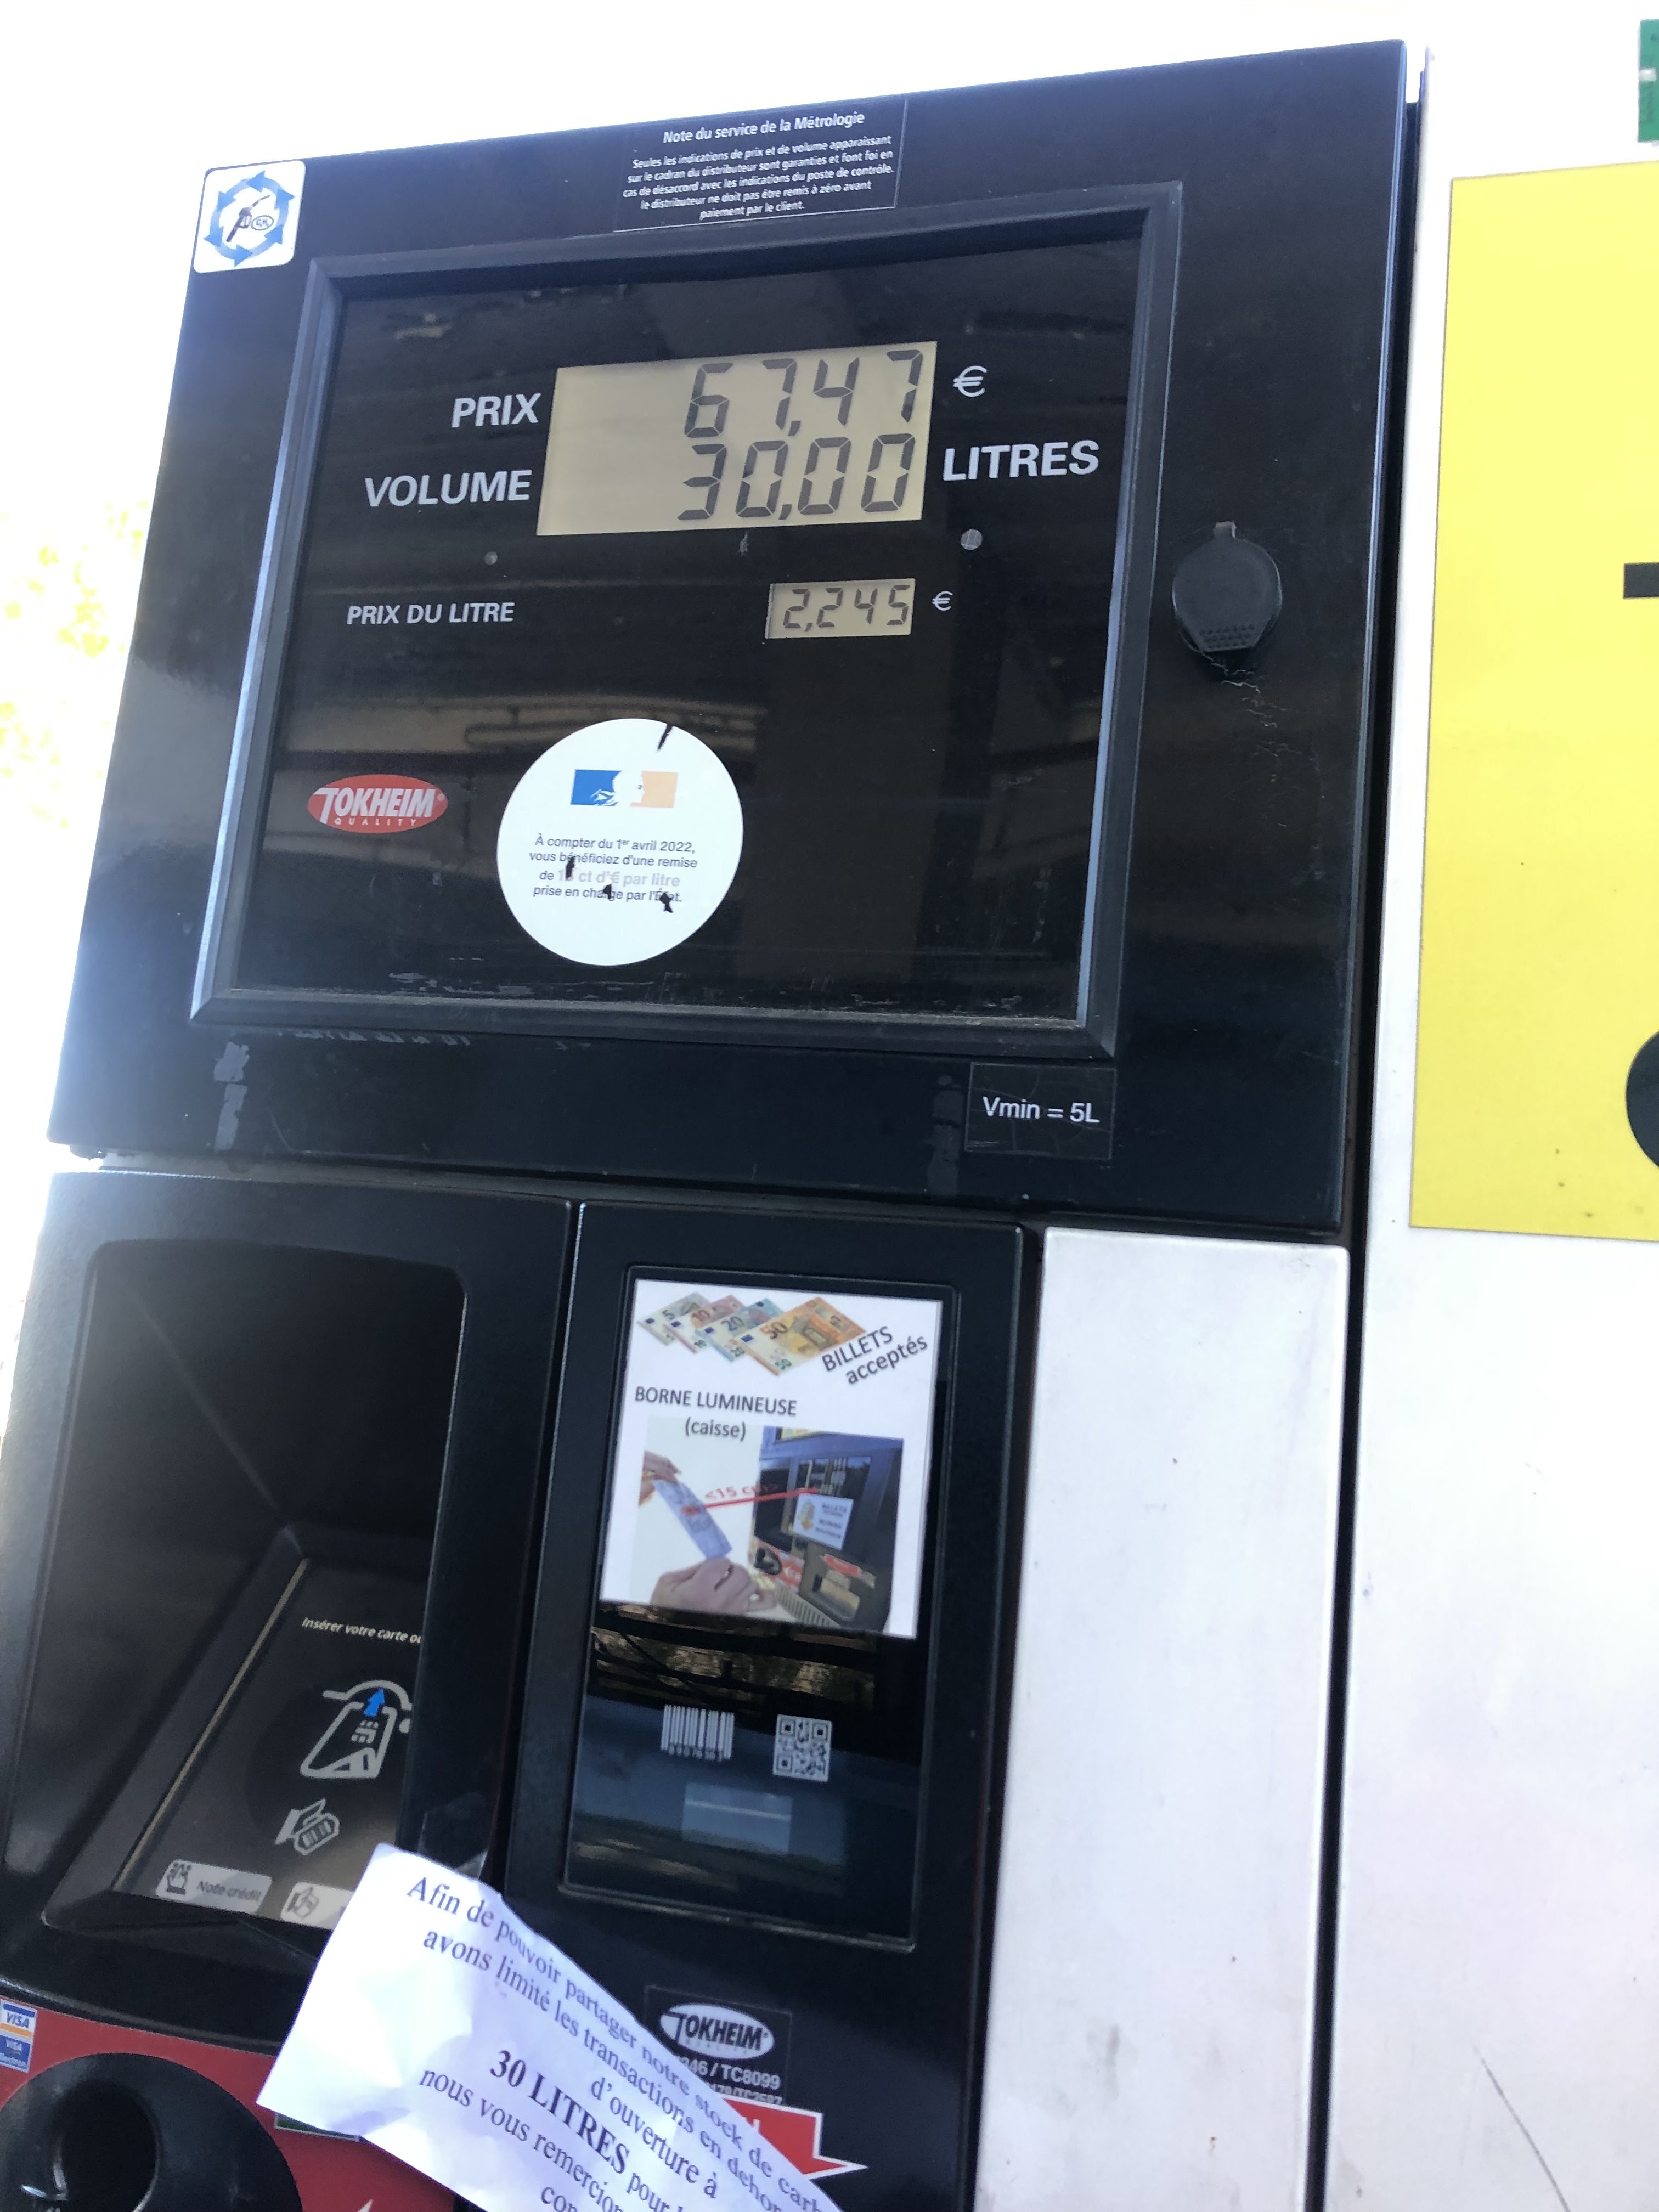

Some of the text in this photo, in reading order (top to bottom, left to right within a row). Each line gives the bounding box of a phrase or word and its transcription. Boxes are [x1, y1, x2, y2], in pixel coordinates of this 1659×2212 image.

[663, 111, 866, 143] Note du service de la Métrologie
[627, 149, 893, 183] sur le cadran du distributeur sont garanties et font foi en
[633, 136, 893, 168] Seules les indications de prix et de volume apparaissant
[639, 186, 651, 196] de
[652, 181, 699, 195] désaccord
[700, 182, 722, 190] avec
[723, 178, 737, 188] les
[738, 173, 791, 187] indications
[792, 171, 806, 182] du
[806, 170, 835, 183] poste
[836, 167, 849, 177] de
[851, 163, 894, 177] contrôle.
[640, 180, 872, 210] le distributeur ne doit pas être remis à zéro avant
[699, 201, 805, 221] paiement par le client.
[684, 349, 923, 438] 67,47
[952, 365, 988, 398] €
[451, 393, 542, 428] PRIX
[942, 439, 1099, 482] LITRES
[364, 469, 533, 507] VOLUME
[676, 433, 916, 521] 30,00
[347, 602, 515, 625] PRIX DU LITRE
[783, 584, 911, 633] 2,245
[932, 590, 953, 612] €
[313, 787, 436, 825] TOKHEIM
[334, 818, 417, 827] QUALITY
[534, 833, 544, 846] À
[547, 837, 596, 850] compter
[597, 838, 613, 849] du
[631, 840, 657, 851] avril
[659, 841, 696, 854] 2022,
[529, 852, 557, 862] vous
[622, 855, 654, 866] d'une
[657, 857, 698, 868] remise
[533, 885, 562, 898] prise
[565, 888, 579, 898] en
[625, 891, 646, 902] par
[648, 888, 682, 902] l'Éat.
[539, 871, 555, 881] de
[578, 872, 592, 883] ct
[623, 873, 647, 888] par
[651, 873, 680, 887] litre
[983, 1096, 1101, 1124] Vmin = 5L
[720, 1316, 745, 1331] 20
[760, 1321, 789, 1340] 50
[822, 1325, 893, 1372] BILLETS
[845, 1335, 928, 1385] acceptés
[635, 1386, 797, 1417] BORNE LUMINEUSE
[685, 1416, 746, 1442] (caisse)
[302, 1617, 345, 1633] Insérer
[345, 1624, 377, 1638] votre
[377, 1629, 408, 1642] carte
[7, 2012, 29, 2029] VISA
[406, 1876, 461, 1916] Afin
[466, 1899, 494, 1928] de
[494, 1920, 562, 1984] pouvoir
[565, 1979, 637, 2049] partager
[642, 2046, 690, 2096] notre
[696, 2094, 743, 2151] stock
[749, 2147, 773, 2178] de
[661, 2010, 763, 2051] TOKHEIM
[423, 1930, 493, 1971] avons
[495, 1955, 550, 2013] limité
[554, 2000, 579, 2037] les
[584, 2028, 694, 2134] transactions
[699, 2130, 721, 2160] en
[720, 2063, 781, 2090] TC8099
[419, 2069, 474, 2107] nous
[480, 2098, 531, 2142] vous
[490, 2050, 670, 2212] 30 LITRES pour
[703, 2171, 718, 2199] à
